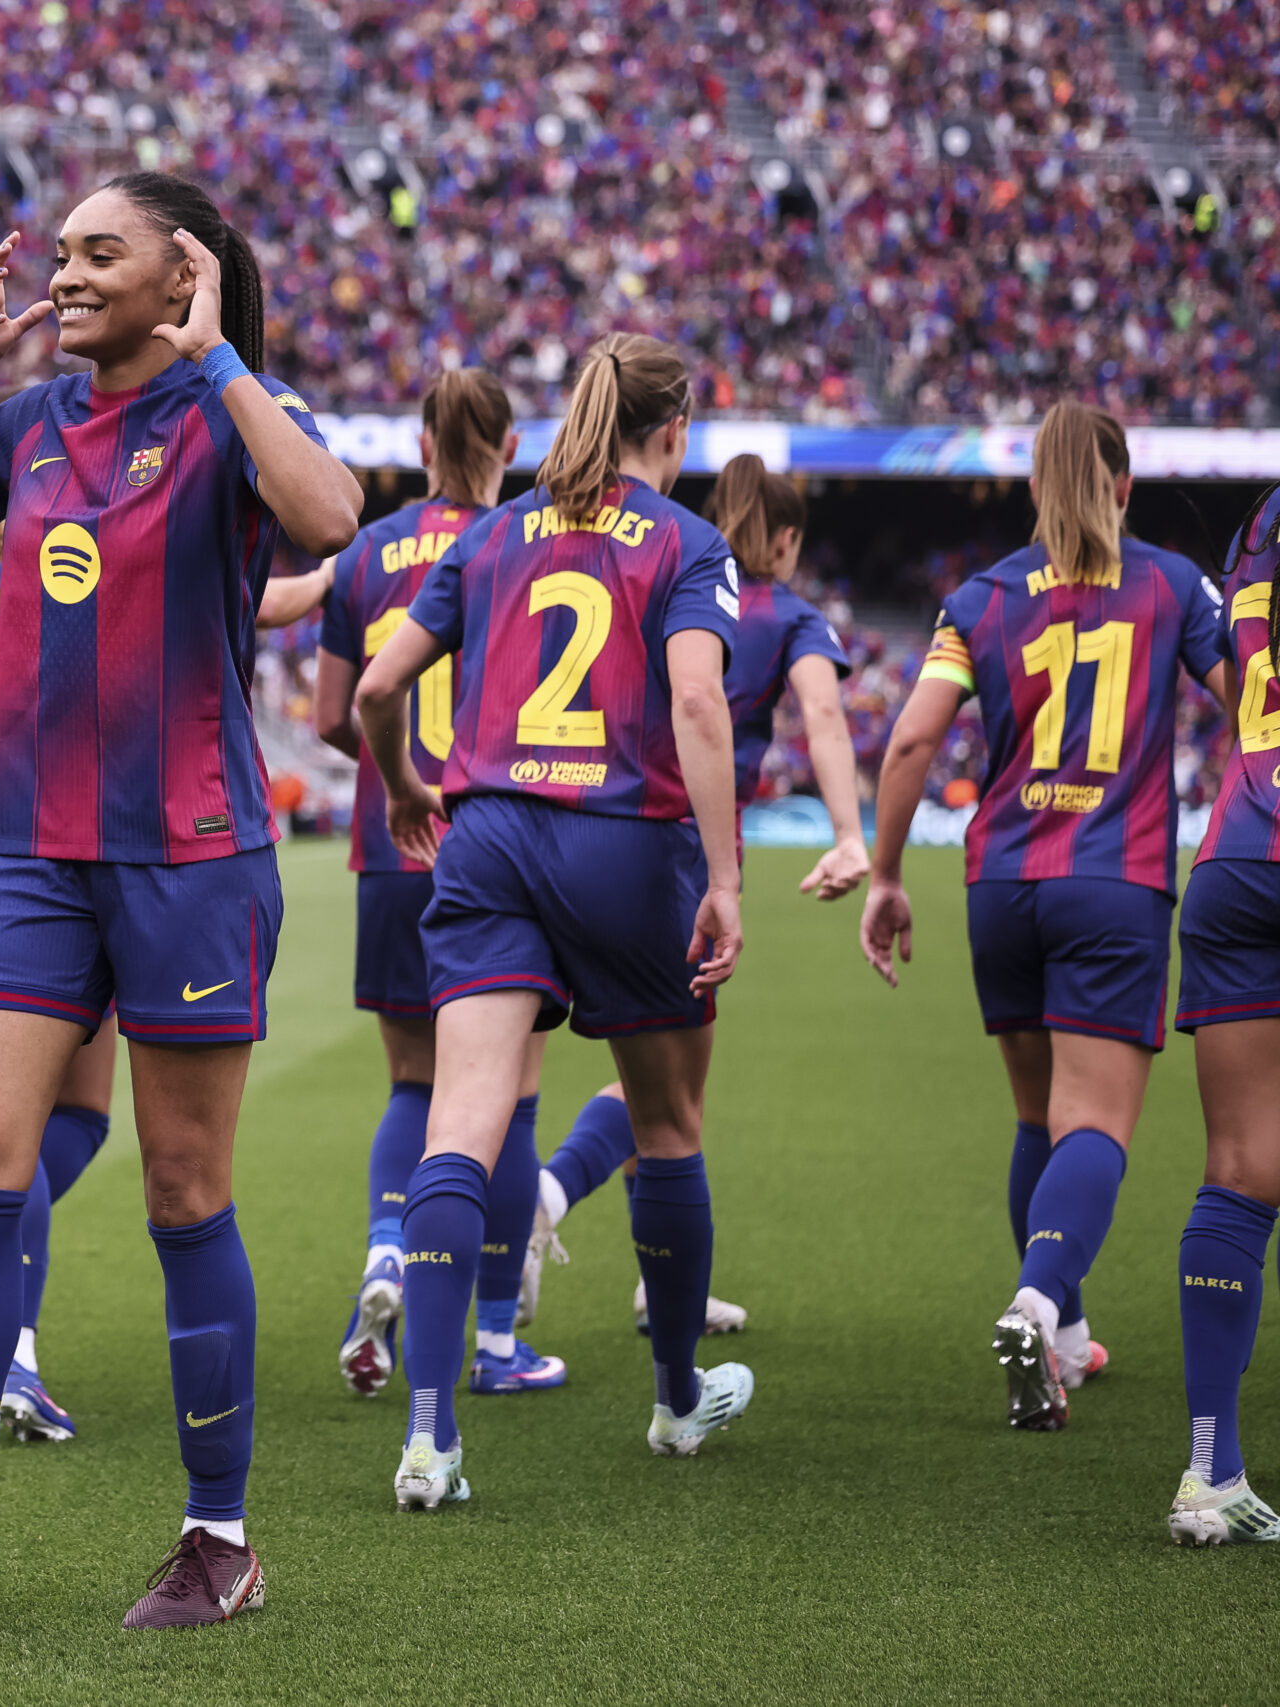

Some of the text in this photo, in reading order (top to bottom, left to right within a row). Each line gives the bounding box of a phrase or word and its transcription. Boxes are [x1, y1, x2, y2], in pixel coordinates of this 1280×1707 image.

[381, 531, 457, 575] GRAH
[1026, 563, 1123, 598] ALA
[516, 570, 613, 747] 2
[1021, 620, 1136, 774] 11
[1185, 1275, 1243, 1292] BARÇA
